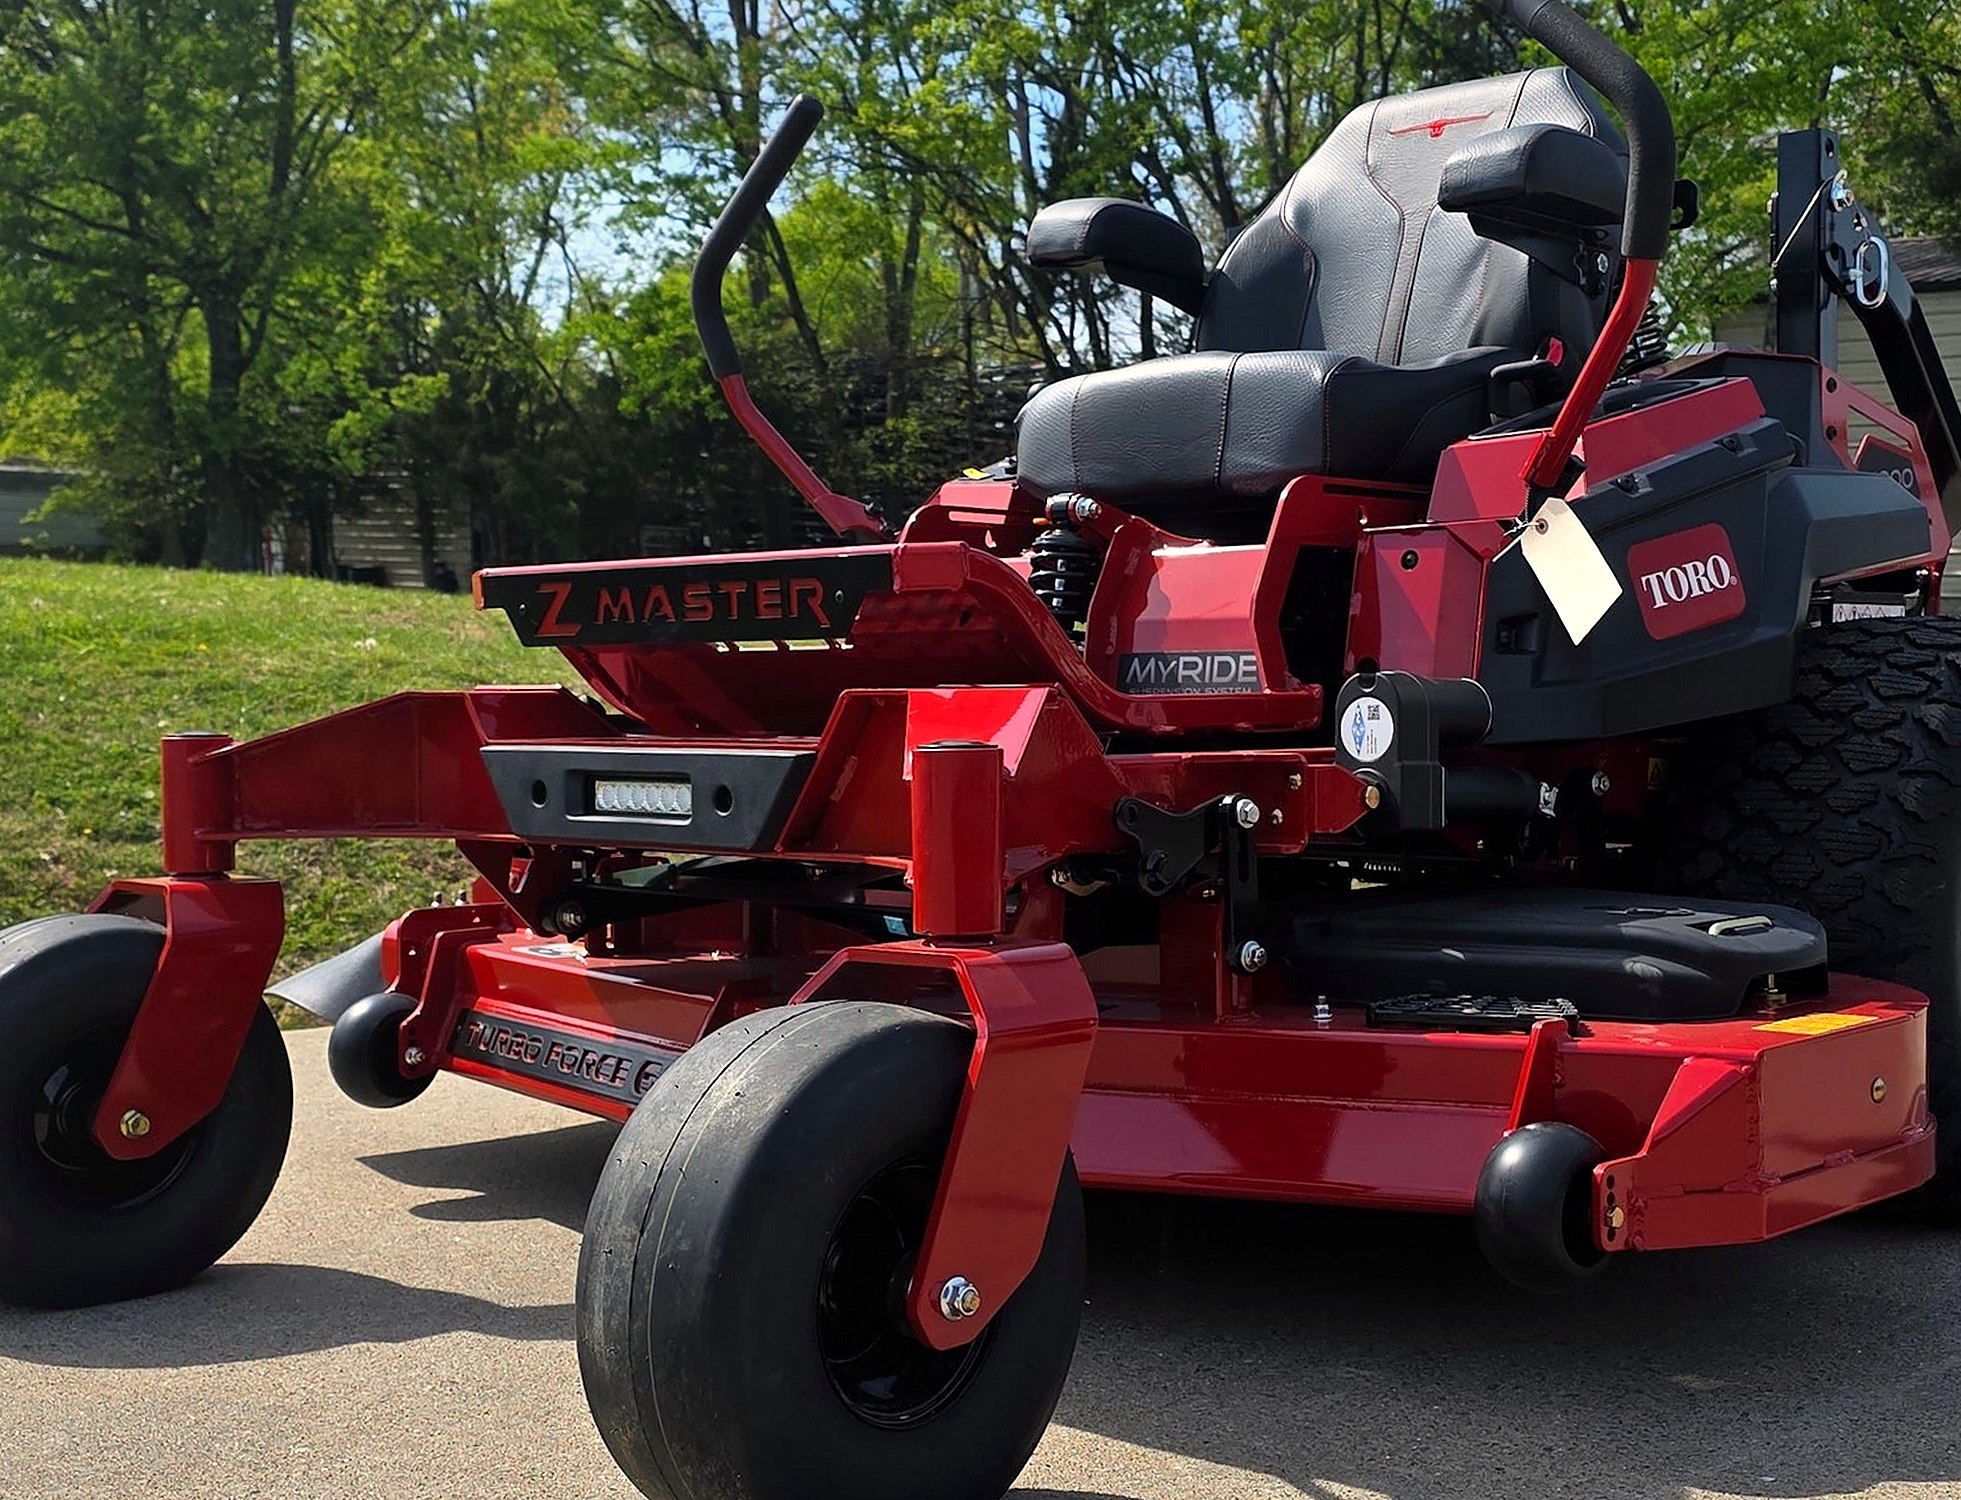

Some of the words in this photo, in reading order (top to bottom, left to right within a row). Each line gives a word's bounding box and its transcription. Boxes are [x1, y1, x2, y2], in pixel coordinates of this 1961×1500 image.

[534, 582, 581, 637] Z
[594, 577, 831, 628] MASTER
[467, 1022, 545, 1065] TURBO
[543, 1041, 633, 1088] FORCE
